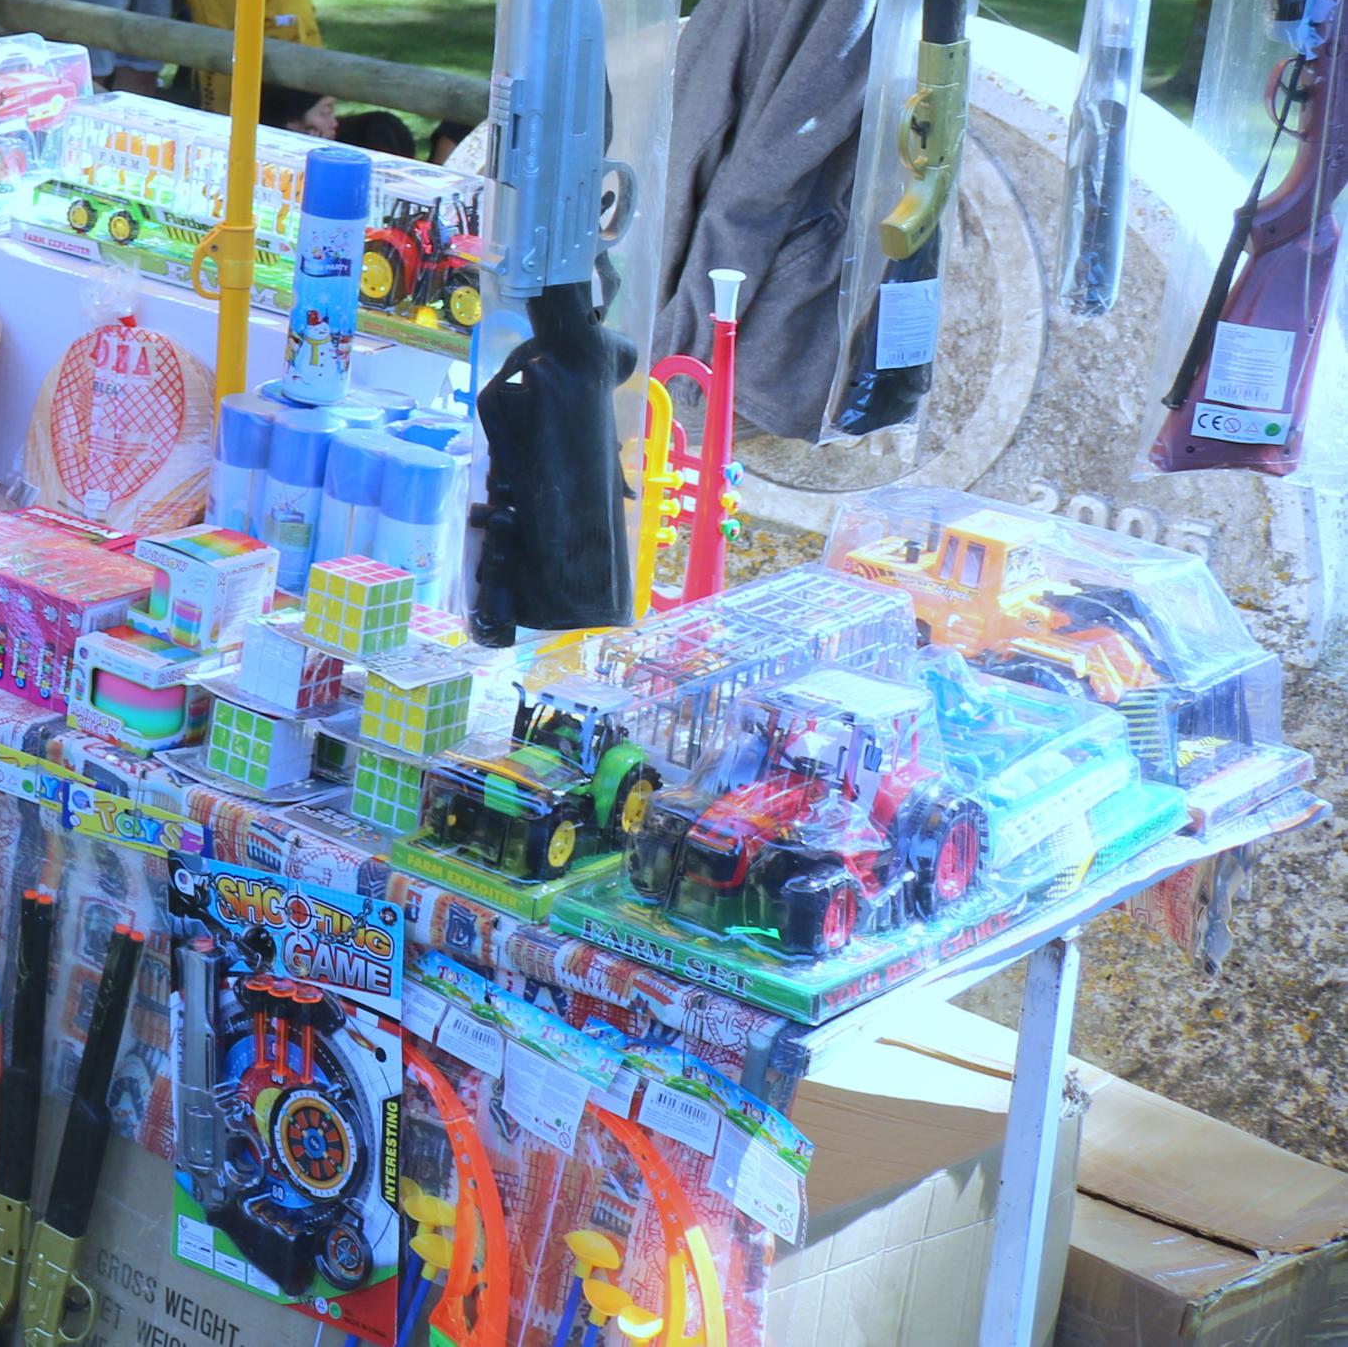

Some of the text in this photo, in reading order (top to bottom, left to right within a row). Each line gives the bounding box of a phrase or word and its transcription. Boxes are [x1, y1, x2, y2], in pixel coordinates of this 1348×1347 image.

[162, 210, 217, 233] Flatbe
[138, 545, 189, 574] RAINBOW
[69, 702, 122, 733] RAINBOW
[93, 800, 185, 851] TOYS
[406, 852, 518, 909] FARM EXPLOITER
[215, 875, 393, 960] SHOOTING
[283, 931, 392, 997] GAME
[580, 916, 755, 998] FARM SET
[385, 1100, 399, 1204] INTERESTING
[96, 1248, 158, 1305] GROSS
